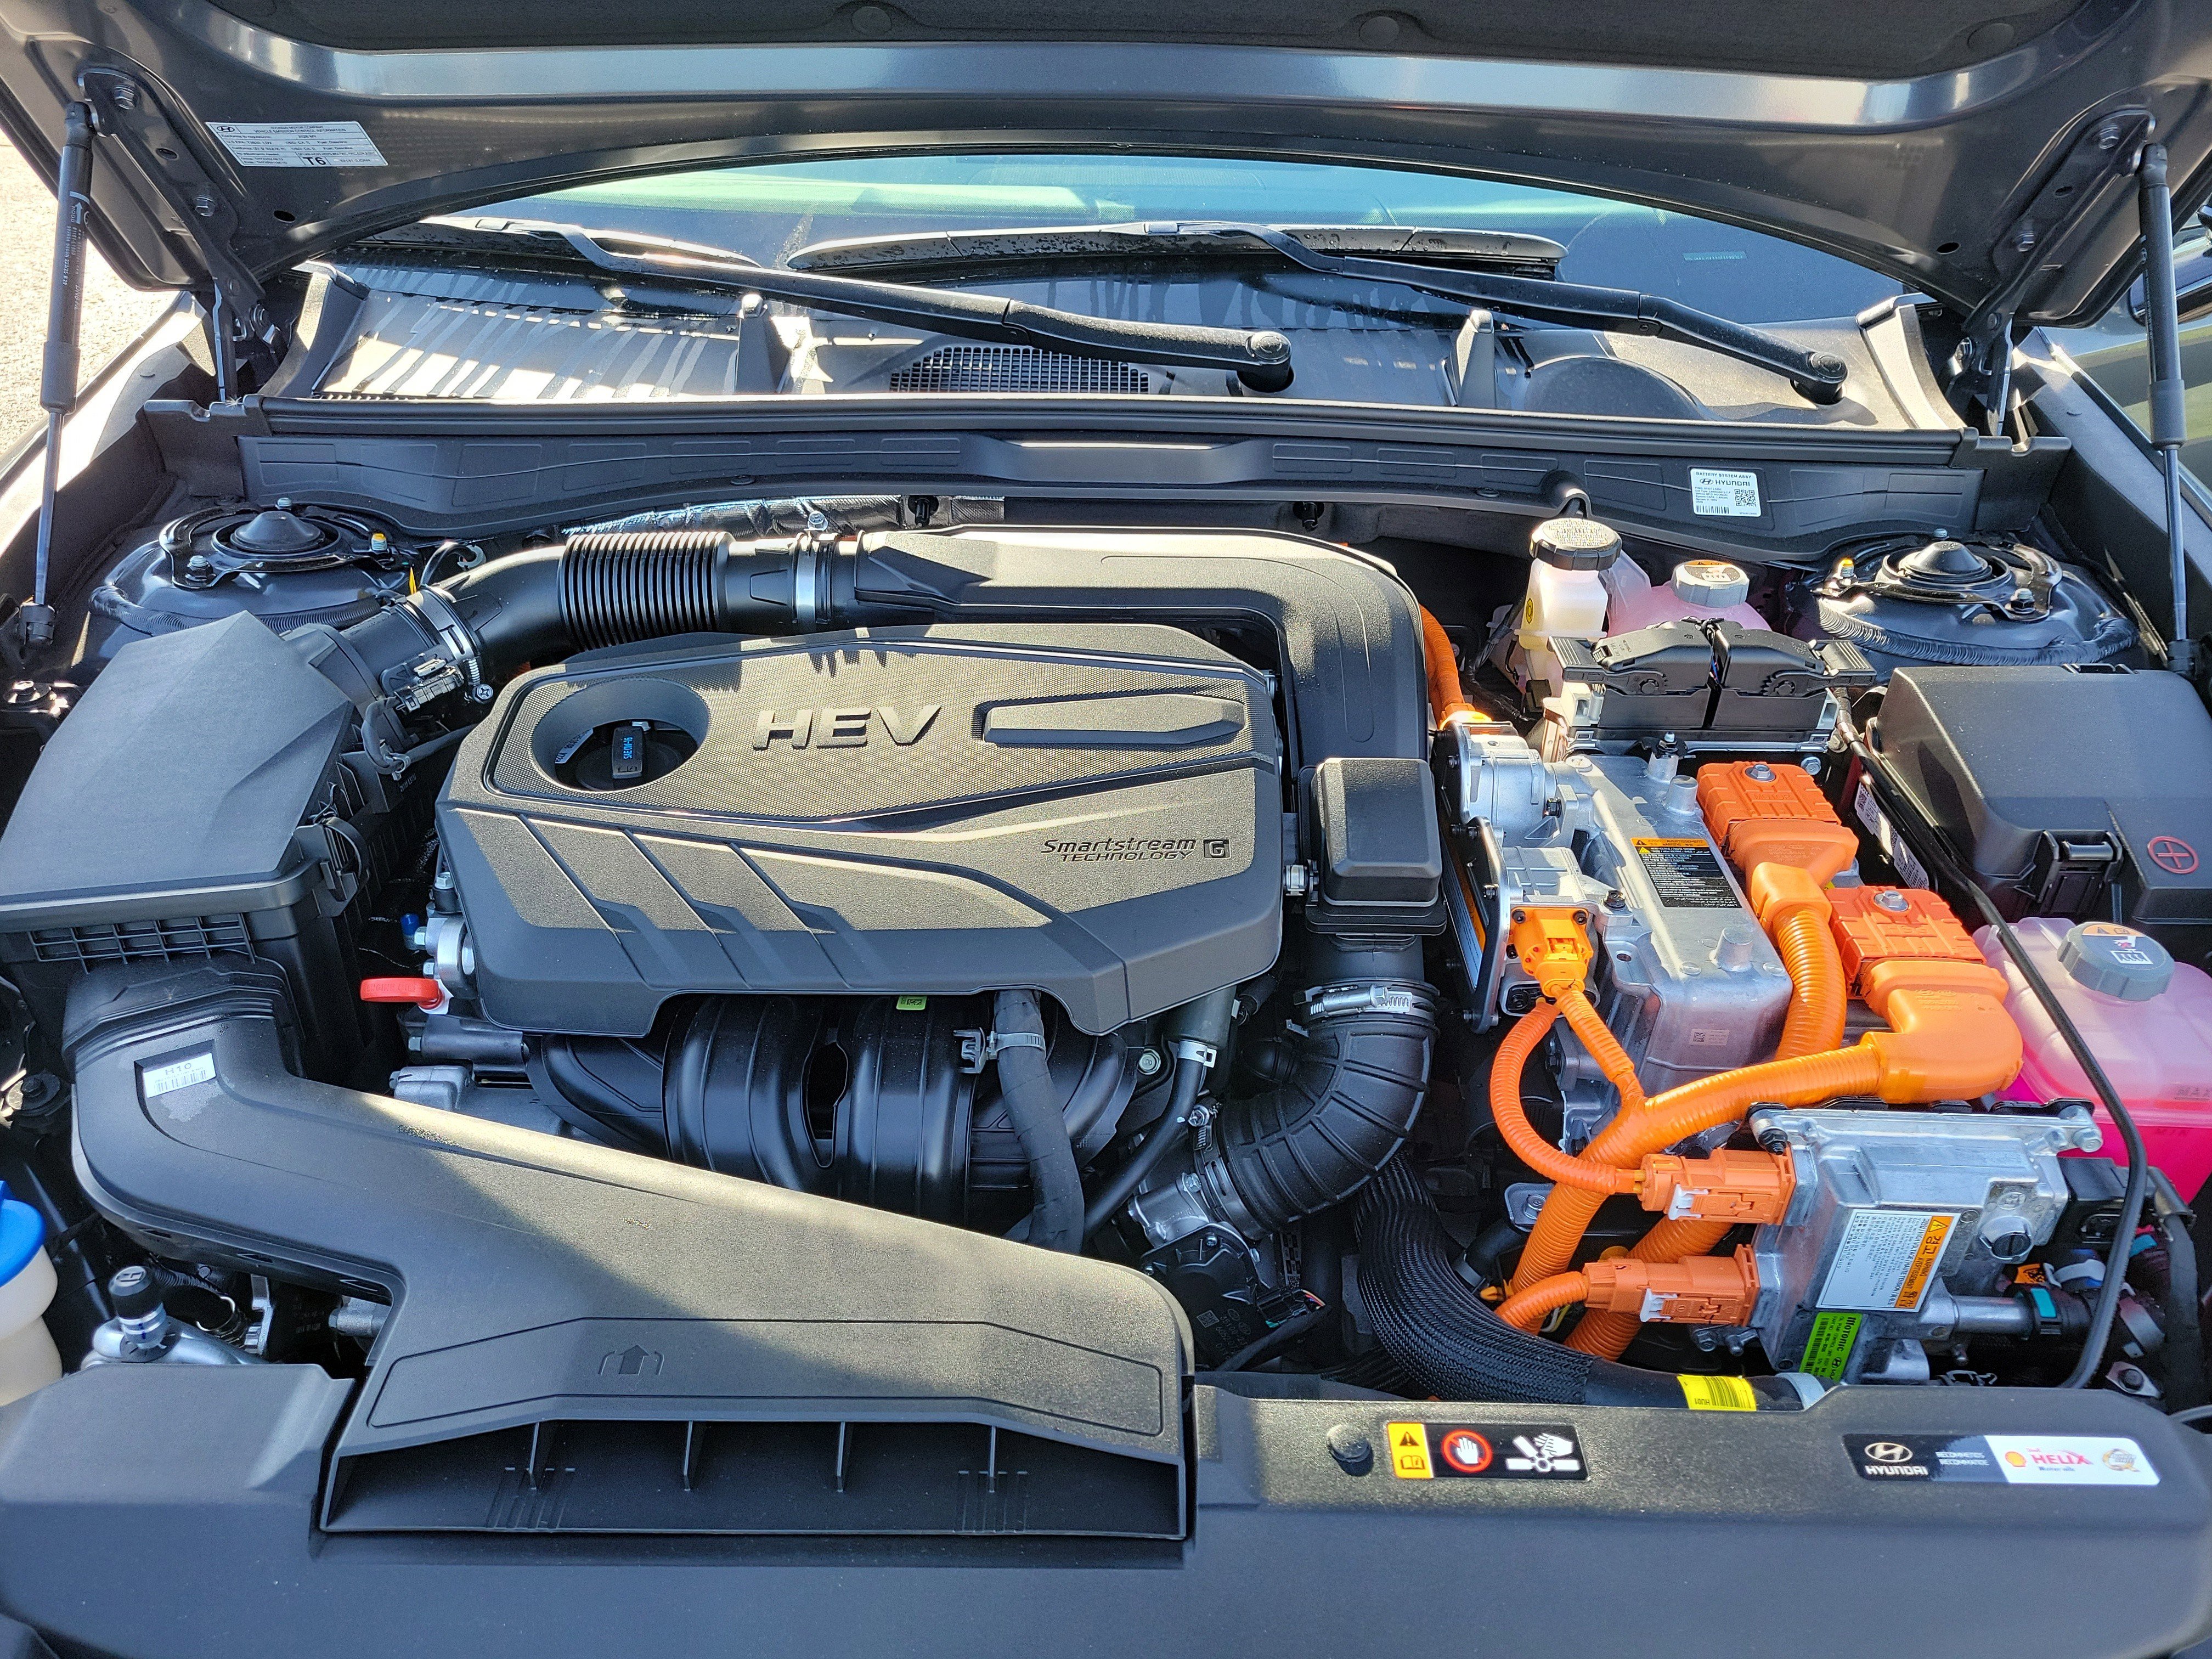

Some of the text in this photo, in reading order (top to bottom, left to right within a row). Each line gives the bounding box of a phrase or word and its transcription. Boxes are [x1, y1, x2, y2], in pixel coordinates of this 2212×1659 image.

[303, 156, 326, 165] T6
[753, 705, 941, 750] HEV
[1041, 838, 1224, 856] Smartstream G
[1062, 851, 1193, 862] TECHNOLOGY
[165, 1063, 192, 1075] H10
[1922, 1235, 1942, 1254] 경고
[1919, 1258, 1934, 1277] WARNING
[2031, 1454, 2092, 1465] HELIX
[1865, 1465, 1928, 1476] HYUNDAI
